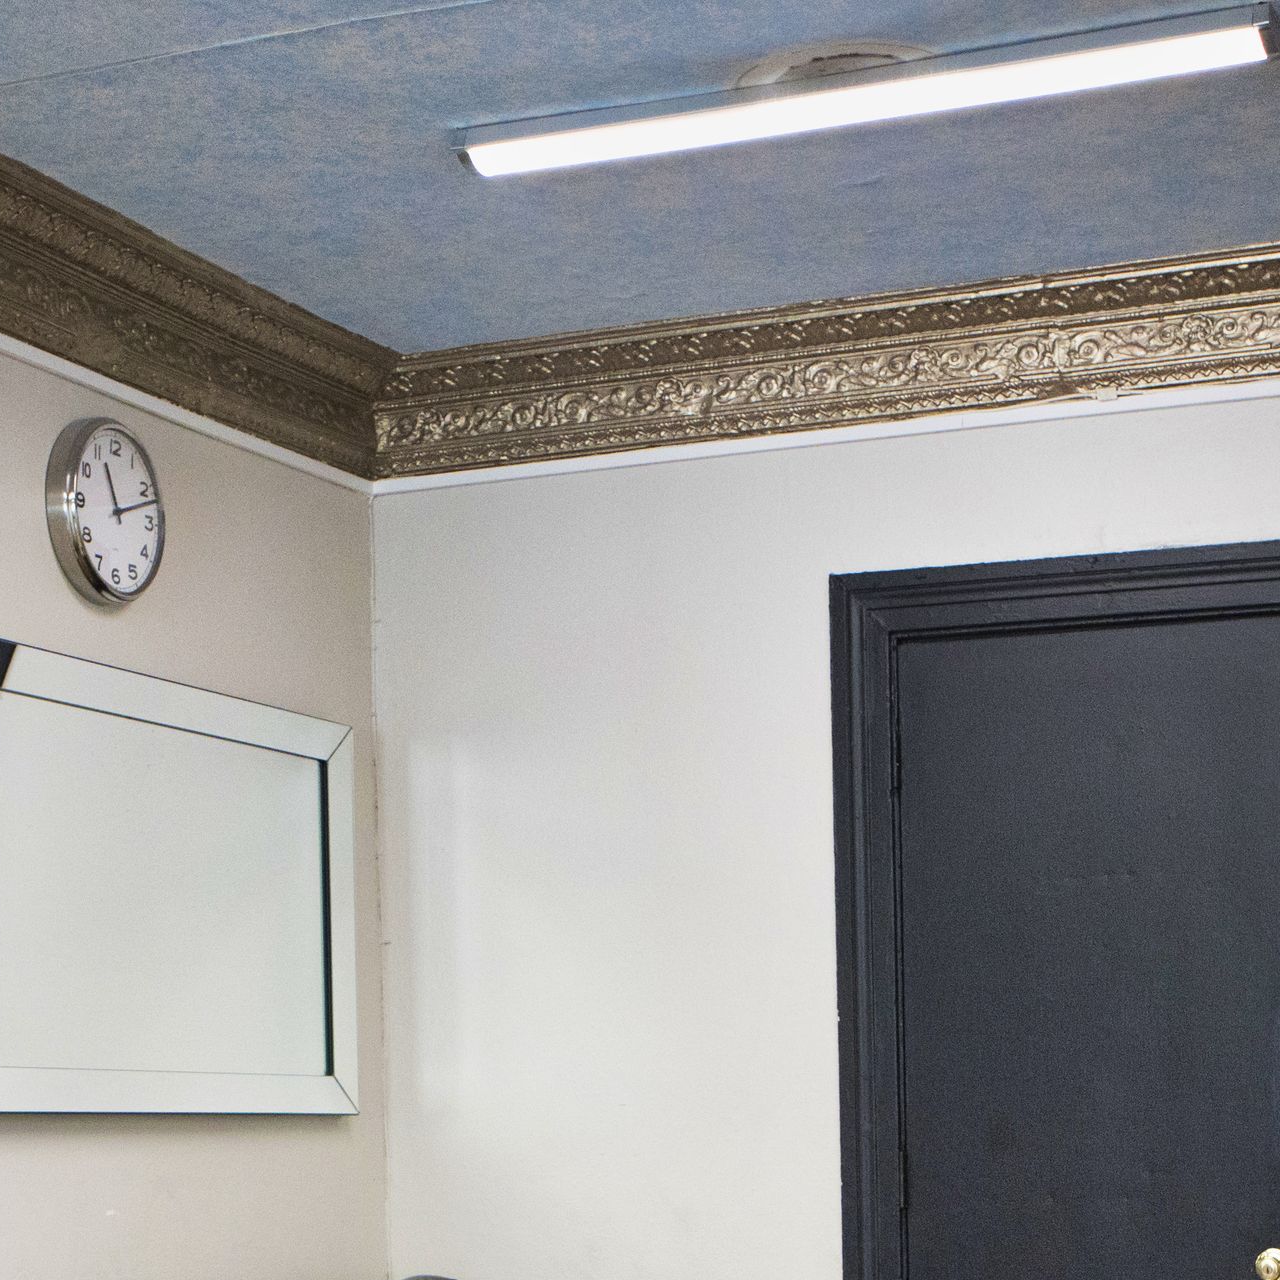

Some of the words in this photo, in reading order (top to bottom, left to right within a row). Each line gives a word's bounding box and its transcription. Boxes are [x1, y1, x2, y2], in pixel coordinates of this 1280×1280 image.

[94, 443, 101, 460] 11
[109, 438, 121, 457] 12
[82, 460, 91, 478] 10
[139, 481, 149, 498] 2
[75, 491, 85, 508] 9
[144, 514, 154, 532] 3
[82, 526, 92, 543] 8
[140, 543, 148, 560] 4
[94, 553, 103, 571] 7
[111, 568, 121, 584] 6
[127, 564, 138, 580] 5
